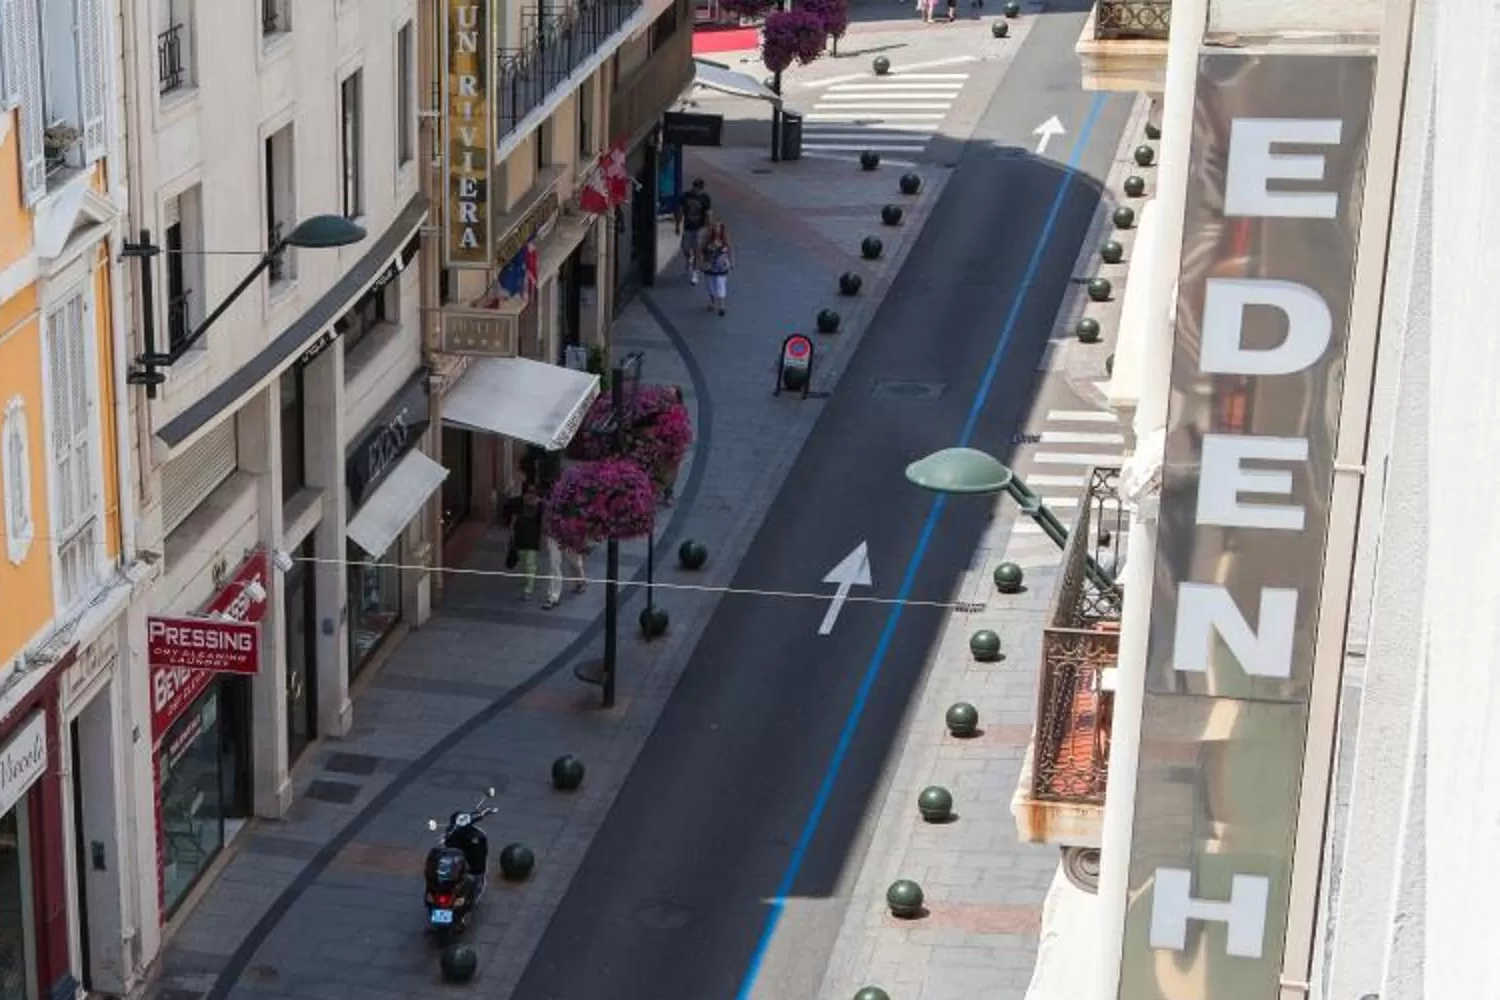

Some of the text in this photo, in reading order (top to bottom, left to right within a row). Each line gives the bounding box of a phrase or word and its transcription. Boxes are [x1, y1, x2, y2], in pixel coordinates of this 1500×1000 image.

[456, 75, 480, 248] RIVIERA
[1172, 117, 1343, 678] EDEN
[148, 621, 253, 652] PRESSING
